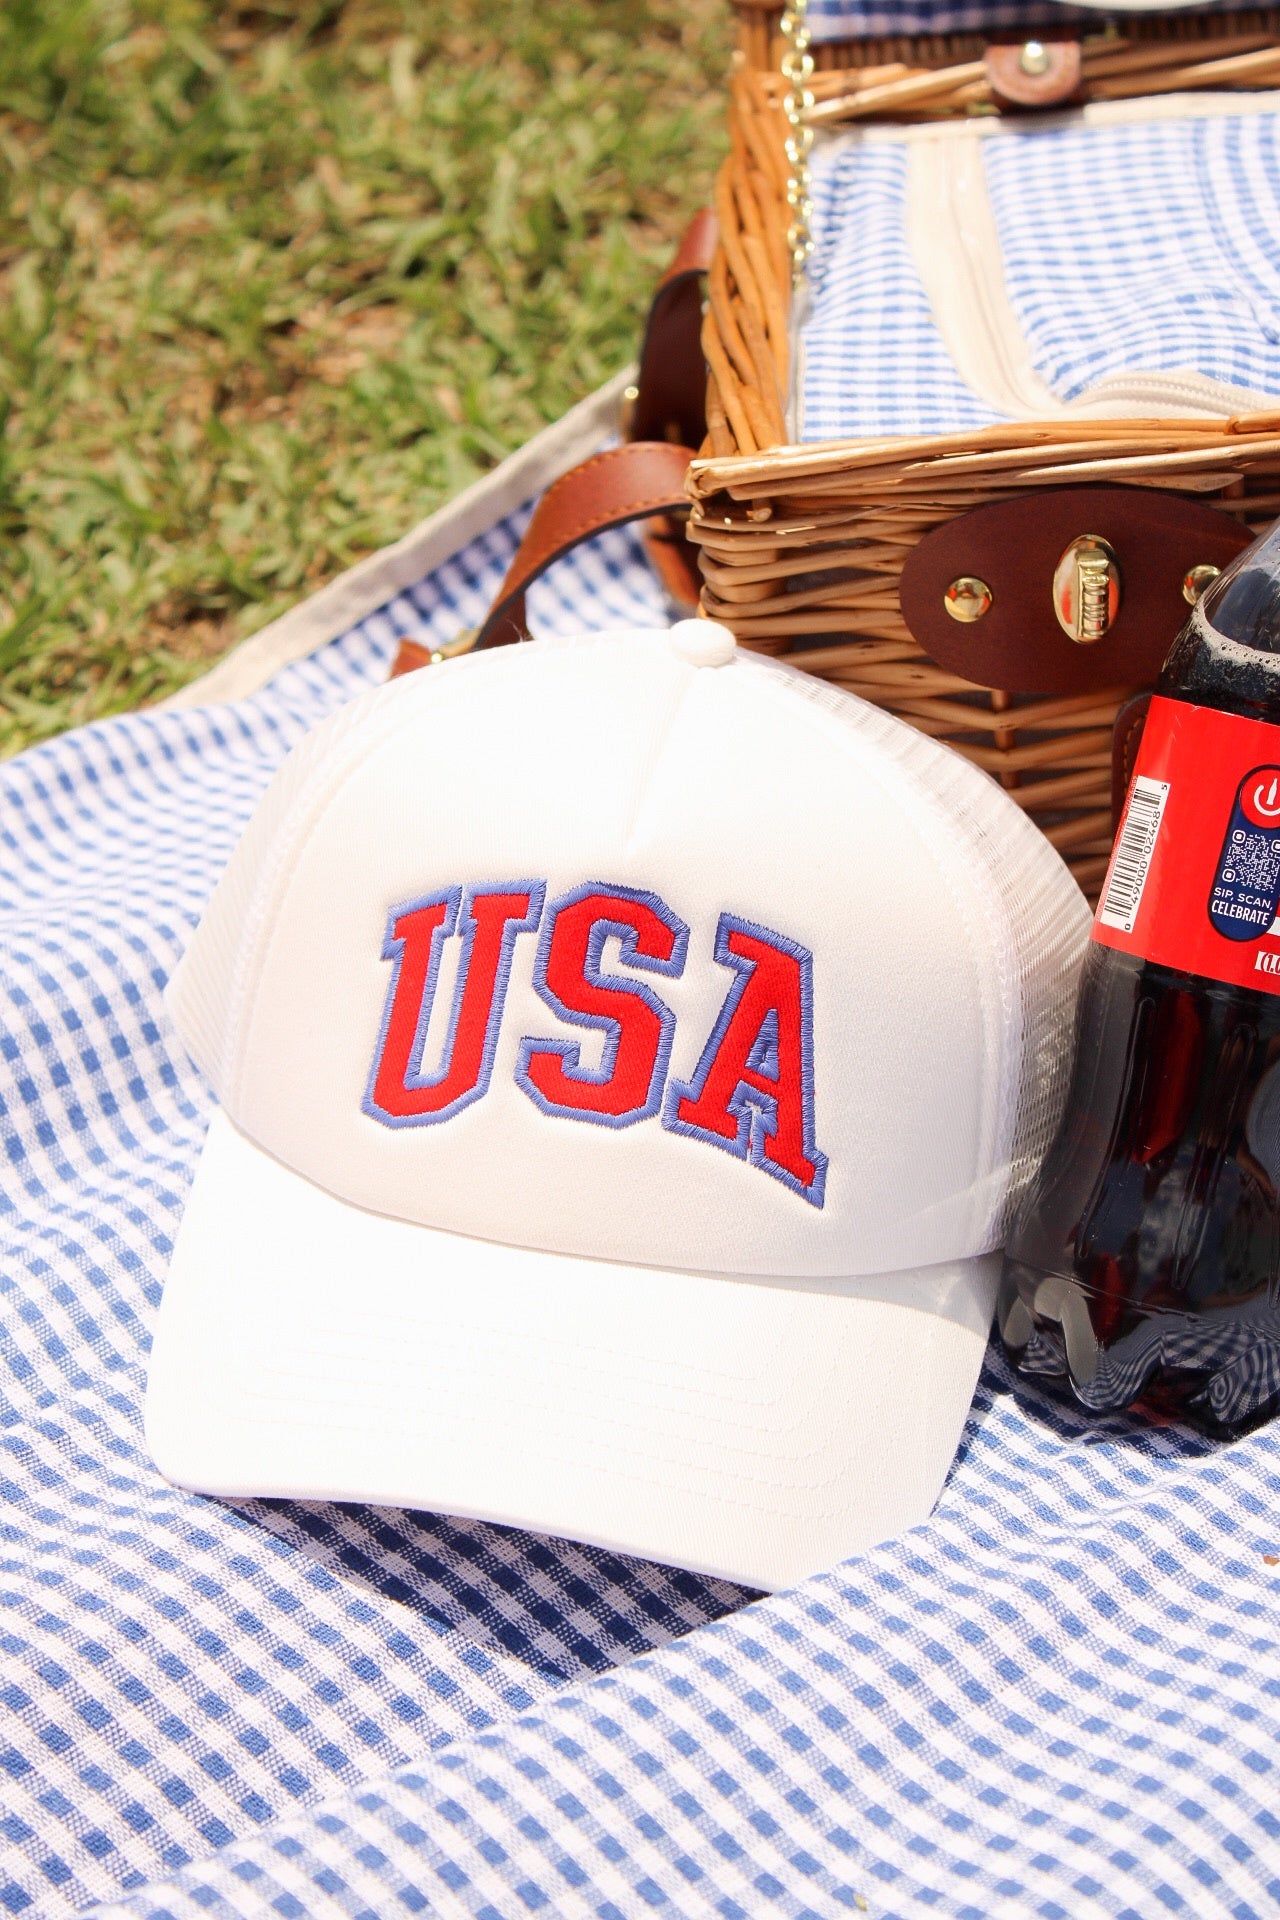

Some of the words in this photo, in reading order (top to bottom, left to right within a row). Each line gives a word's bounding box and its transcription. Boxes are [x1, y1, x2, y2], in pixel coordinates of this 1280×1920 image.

[1125, 923, 1132, 931] 0
[1131, 860, 1148, 905] 49000
[1143, 811, 1161, 855] 02468
[1161, 783, 1168, 791] 5
[1213, 887, 1234, 901] SIP,
[1237, 893, 1273, 911] SCAN,
[1211, 899, 1271, 926] CELEBRATE
[361, 879, 829, 1210] USA
